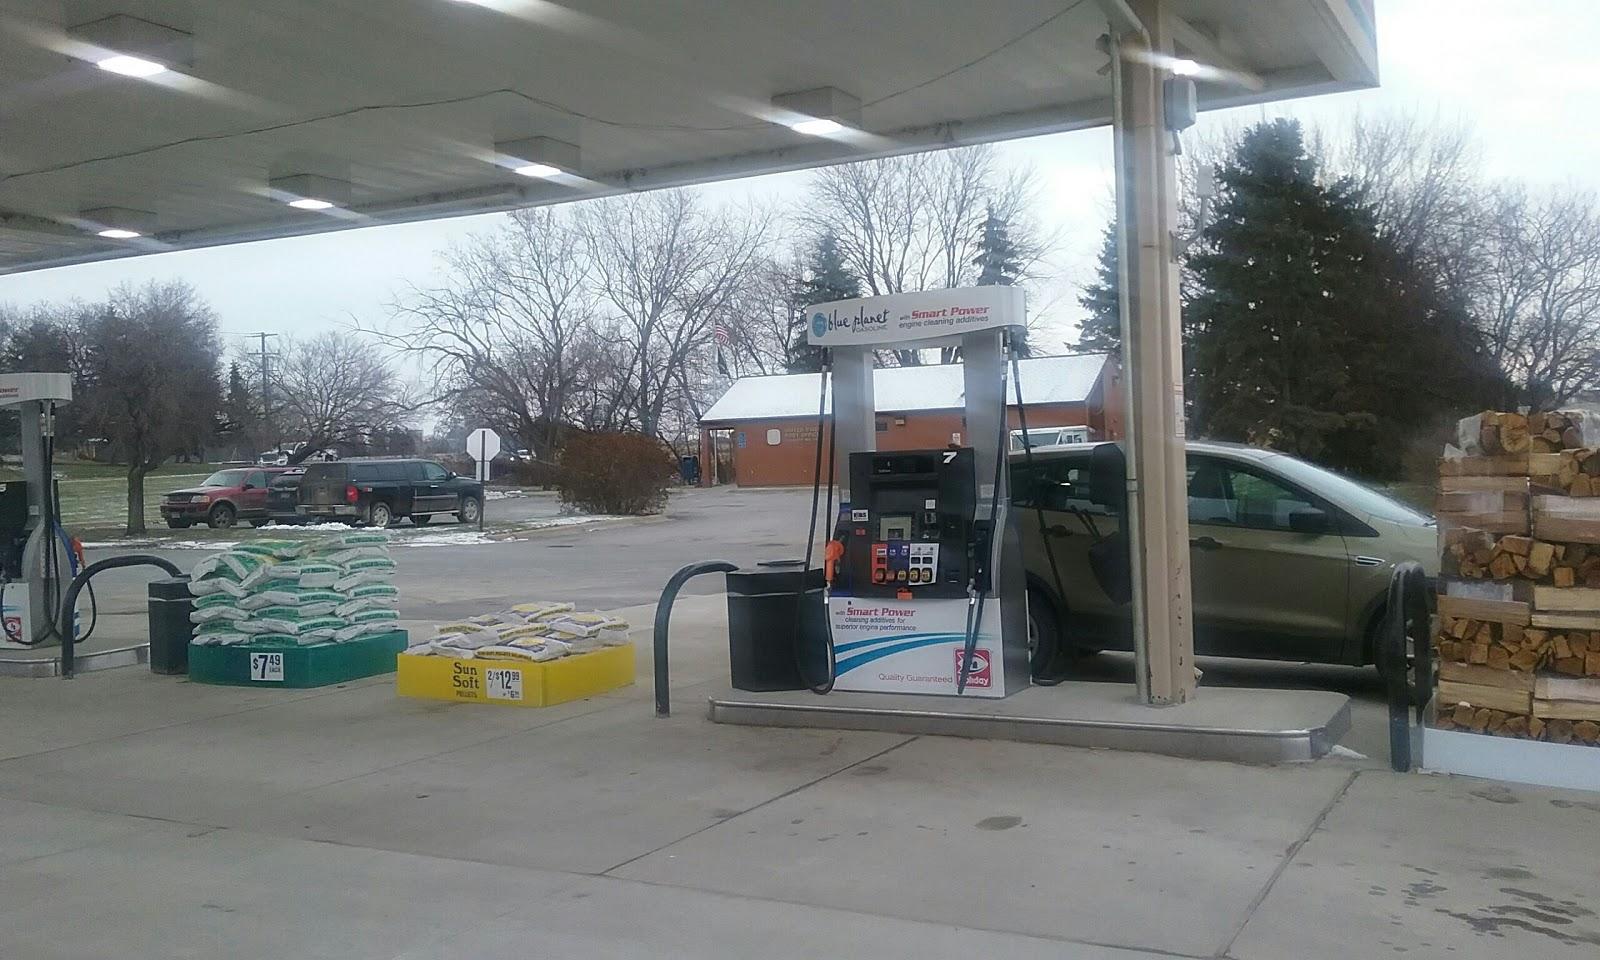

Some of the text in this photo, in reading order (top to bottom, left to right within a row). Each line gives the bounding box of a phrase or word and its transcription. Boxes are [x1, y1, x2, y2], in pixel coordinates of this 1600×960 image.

[827, 305, 891, 334] blue planet
[911, 308, 948, 321] Smart
[950, 305, 990, 318] Power
[898, 314, 989, 330] engine cleaning additives
[942, 452, 957, 464] 7
[846, 607, 879, 617] Smart
[881, 607, 916, 617] Power
[845, 617, 869, 625] cleaning
[453, 661, 478, 676] Sun
[452, 675, 480, 689] Soft
[877, 672, 953, 684] Quality Guaranteed
